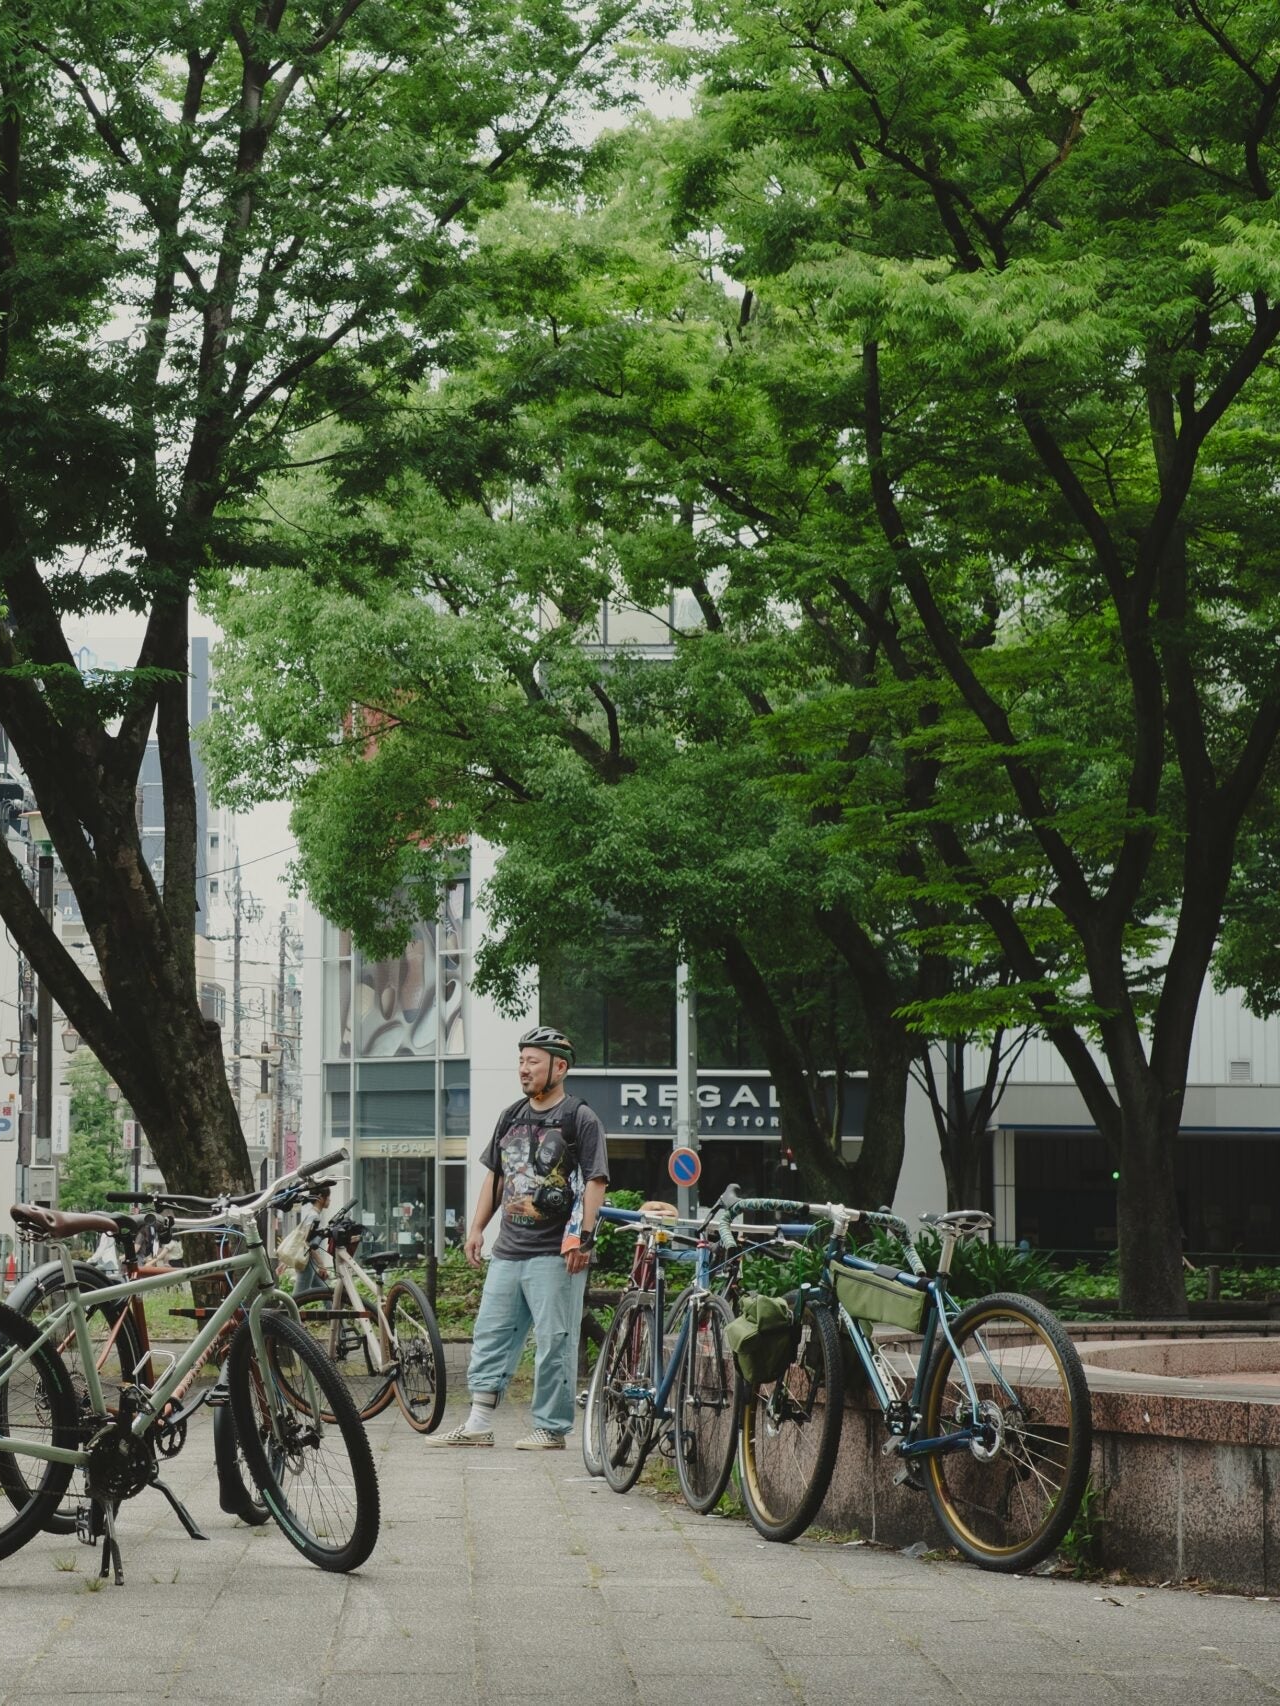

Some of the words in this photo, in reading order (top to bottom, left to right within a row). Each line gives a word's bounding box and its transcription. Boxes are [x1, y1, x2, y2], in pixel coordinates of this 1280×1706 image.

[620, 1083, 781, 1108] REGAL
[621, 1114, 716, 1128] FACTY
[726, 1115, 780, 1128] STOR
[379, 1143, 432, 1154] REGAL
